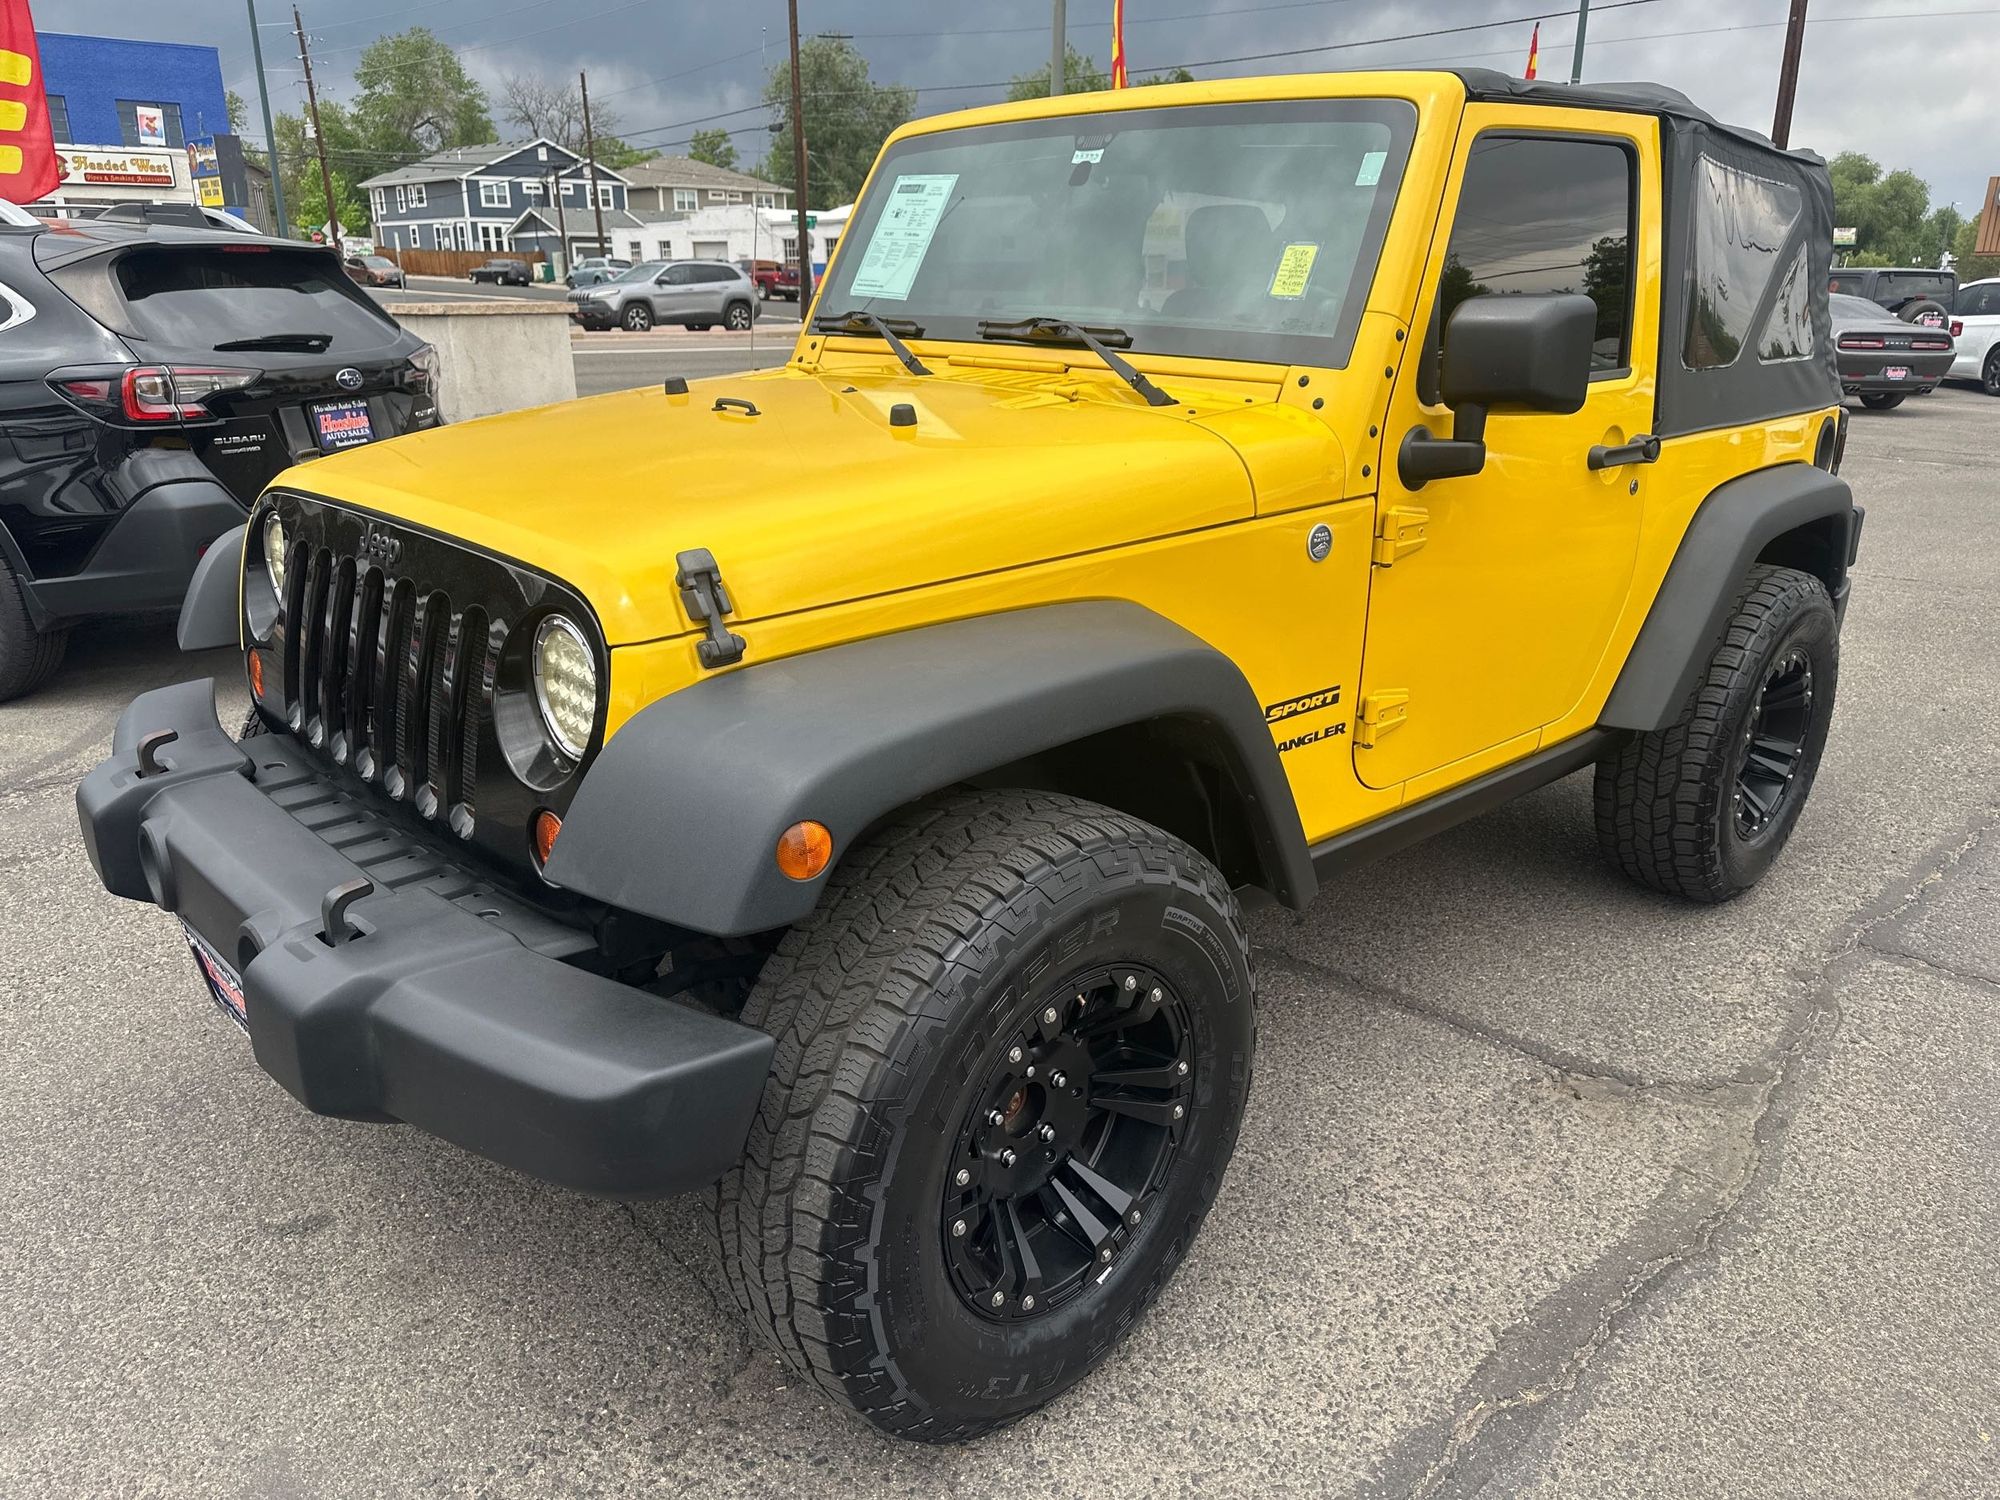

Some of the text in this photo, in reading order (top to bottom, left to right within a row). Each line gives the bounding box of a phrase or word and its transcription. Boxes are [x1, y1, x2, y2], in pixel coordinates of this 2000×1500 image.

[71, 155, 169, 173] Headed West
[352, 400, 367, 409] Sles
[213, 433, 266, 445] SUBARU
[326, 428, 370, 440] AUTO SALES
[359, 523, 401, 567] Jeep
[1265, 690, 1340, 721] SPORT
[1277, 722, 1346, 754] ANGLER
[1165, 911, 1203, 931] ADAPTIVE
